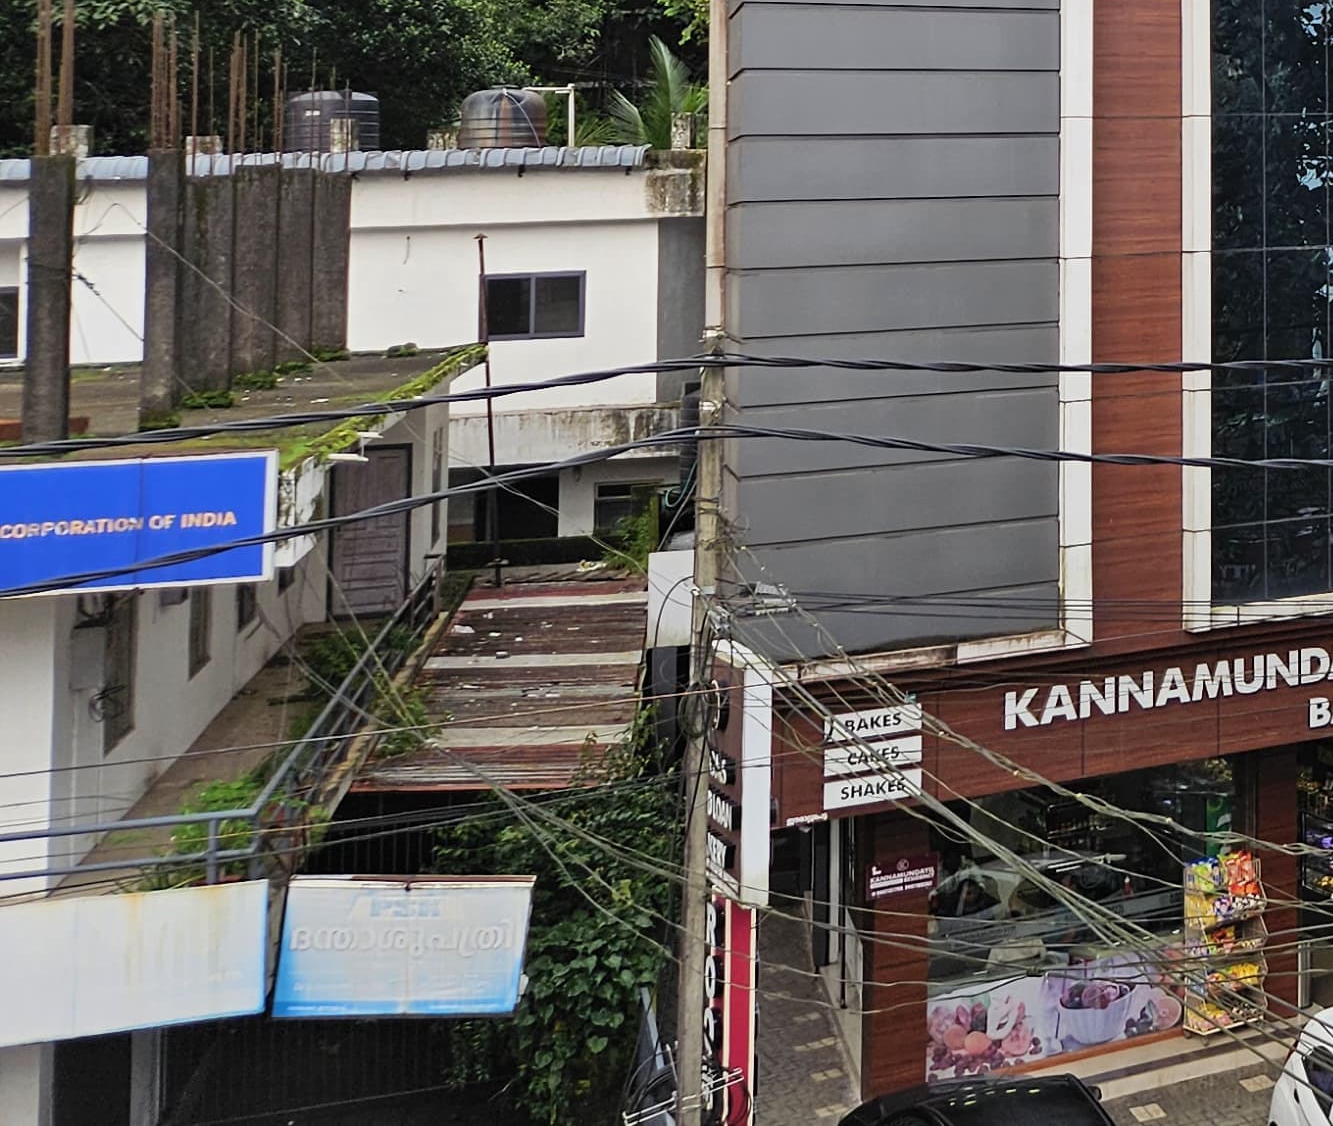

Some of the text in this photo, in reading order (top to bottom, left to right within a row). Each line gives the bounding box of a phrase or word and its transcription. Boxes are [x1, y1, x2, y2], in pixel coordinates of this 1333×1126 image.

[0, 510, 238, 539] CORPORATION OF INDIA
[843, 712, 902, 733] BAKES
